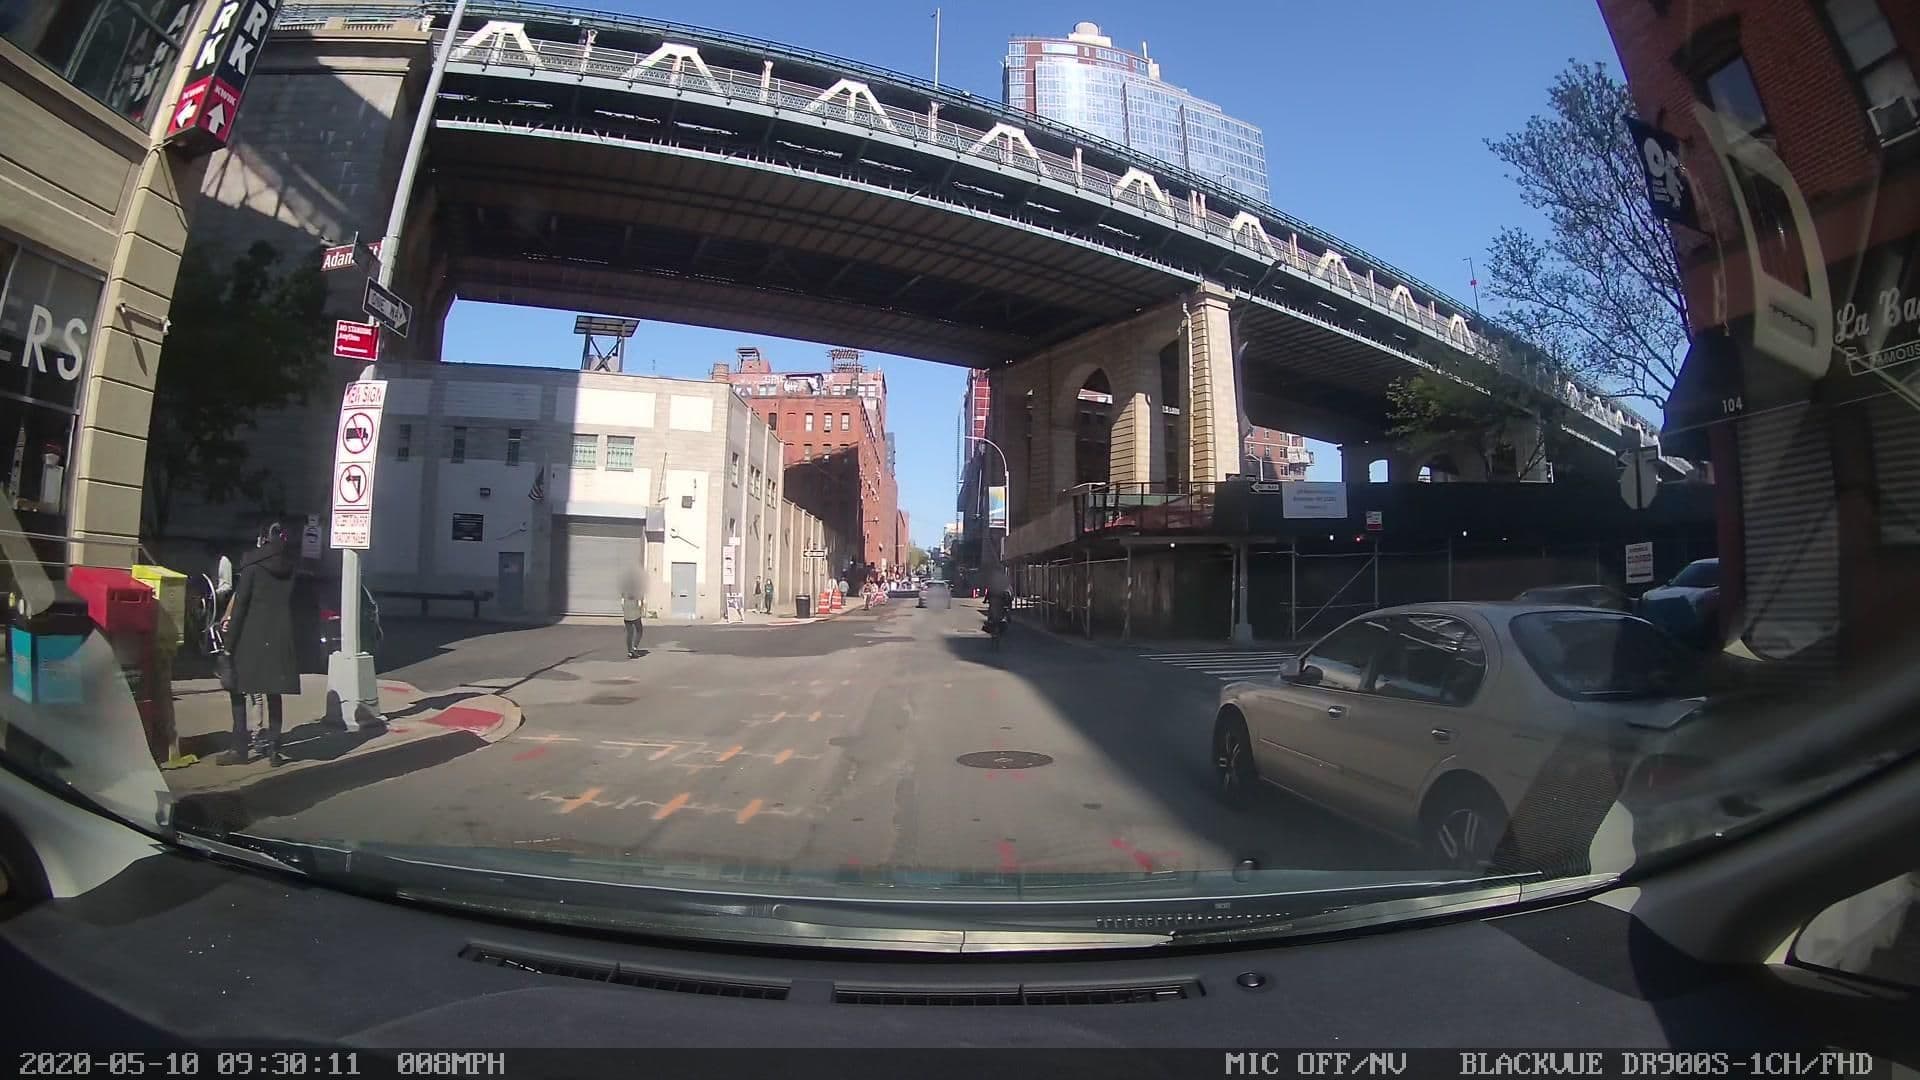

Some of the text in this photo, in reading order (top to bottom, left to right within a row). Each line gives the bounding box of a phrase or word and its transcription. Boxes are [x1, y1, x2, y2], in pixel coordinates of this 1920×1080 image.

[1879, 287, 1920, 334] Ba
[362, 386, 382, 402] SIGN
[1722, 396, 1743, 414] 104
